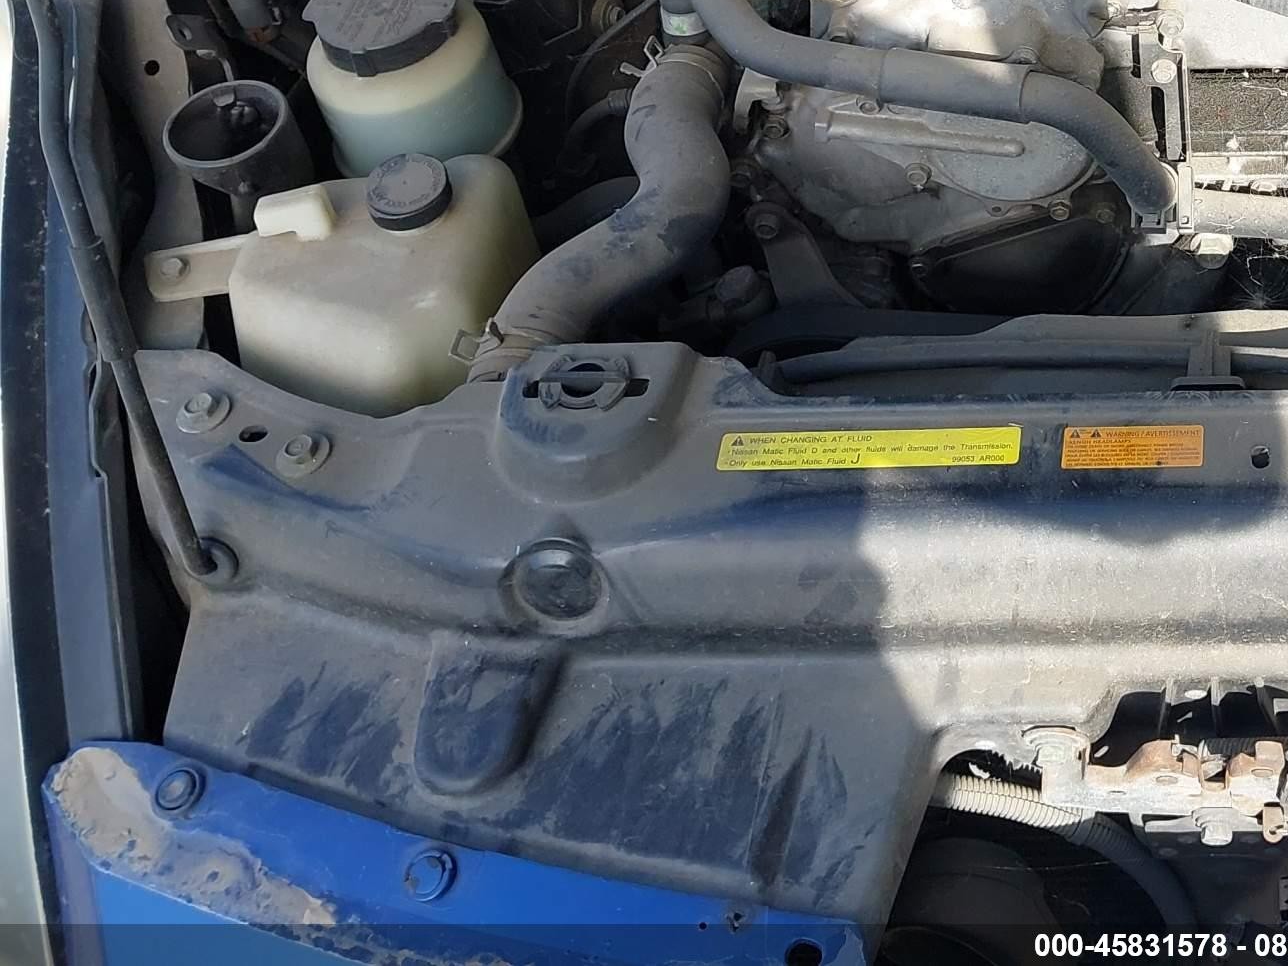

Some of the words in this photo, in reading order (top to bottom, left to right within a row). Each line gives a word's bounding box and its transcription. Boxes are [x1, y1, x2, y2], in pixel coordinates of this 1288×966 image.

[749, 436, 776, 444] WHEN
[780, 435, 827, 444] CHANGING
[831, 435, 843, 443] AT
[847, 435, 873, 443] FLUID
[731, 447, 759, 455] Nissan
[762, 446, 784, 455] Matic
[788, 446, 808, 454] Fluid
[812, 446, 818, 454] D
[822, 446, 837, 454] and
[907, 444, 938, 453] damage
[729, 459, 747, 468] Only
[769, 458, 797, 466] Nissan
[850, 453, 861, 465] J
[952, 455, 976, 463] 99053
[979, 454, 1005, 462] AR000
